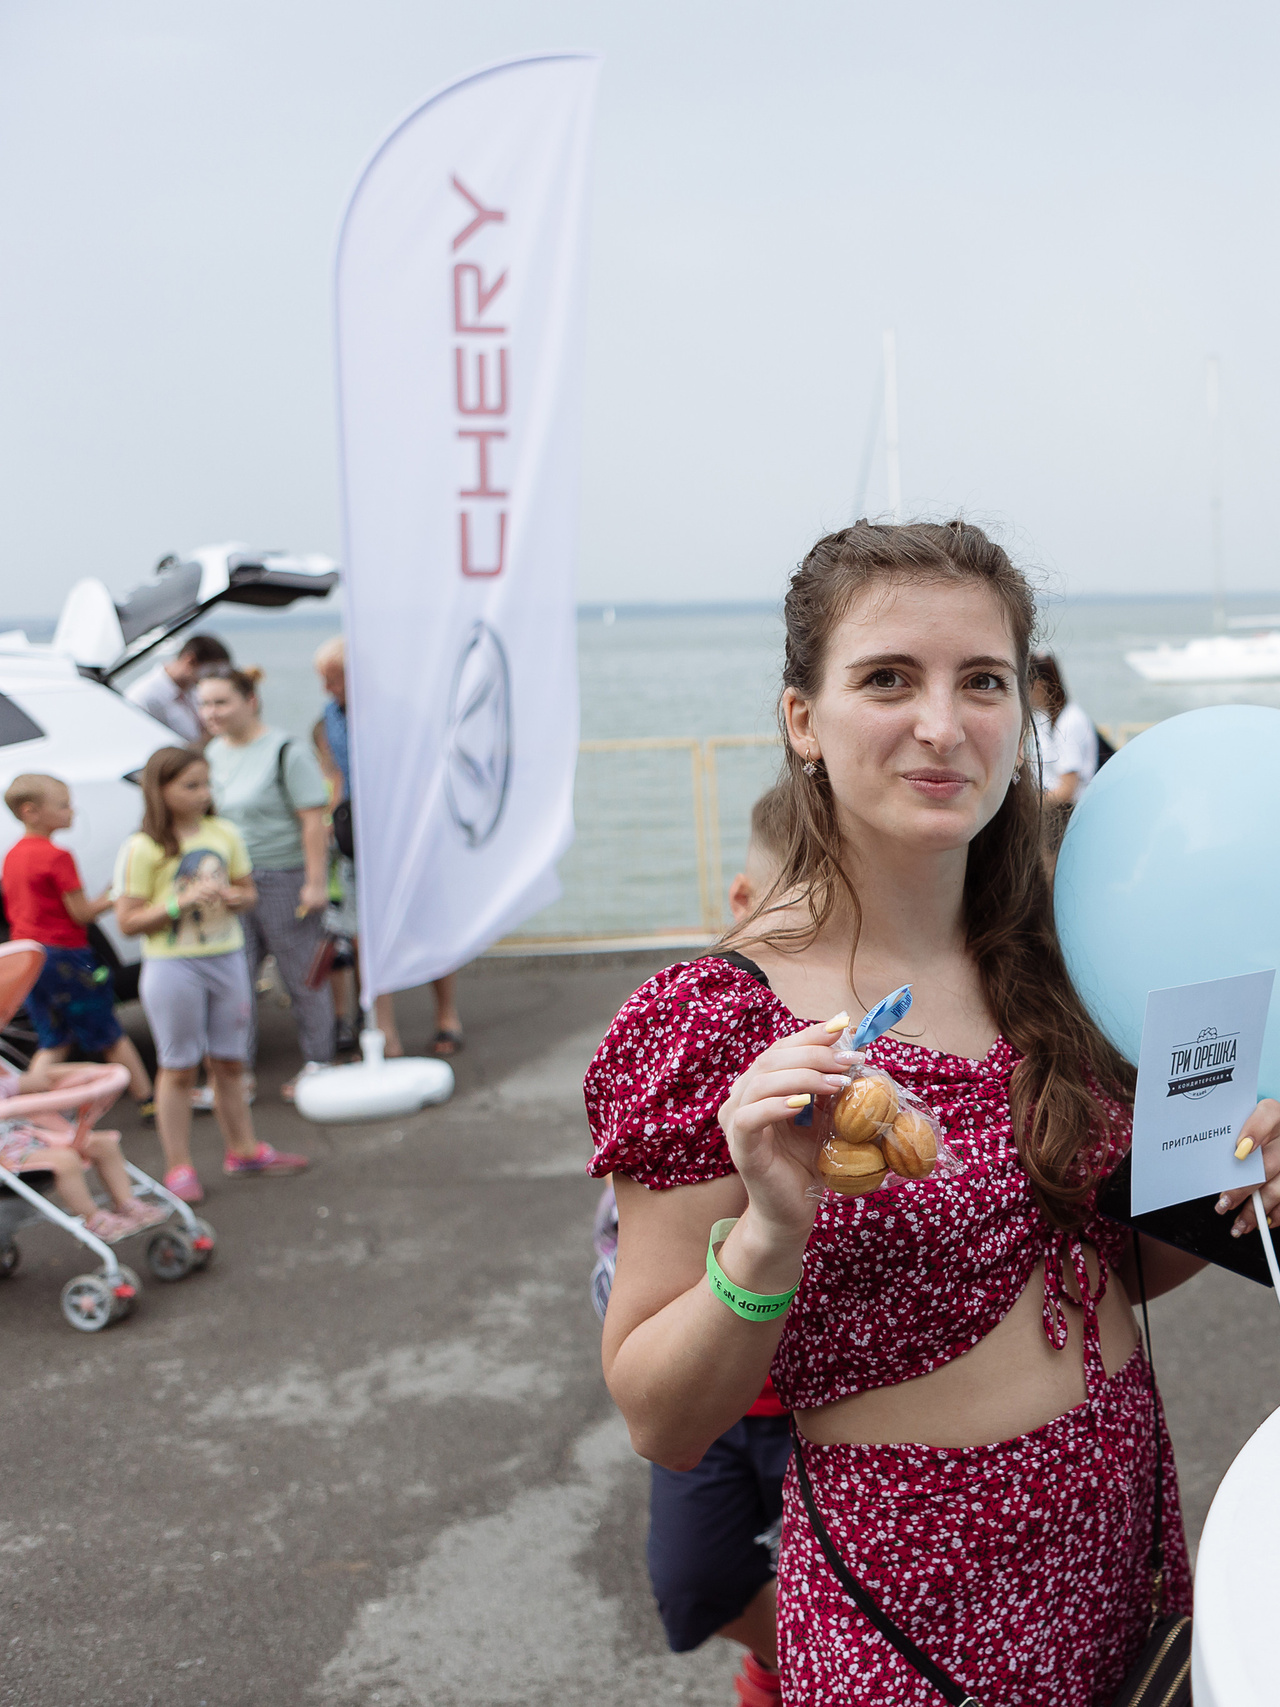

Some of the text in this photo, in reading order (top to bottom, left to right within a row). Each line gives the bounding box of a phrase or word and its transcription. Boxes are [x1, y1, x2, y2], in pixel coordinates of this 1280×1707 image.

[451, 173, 508, 579] CHERY
[1170, 1039, 1236, 1075] ТРИ ОРЕШКА
[1177, 1074, 1224, 1089] КОНДИТЕРСКАЯ
[1161, 1125, 1232, 1151] ПРИГЛАШЕНИЕ
